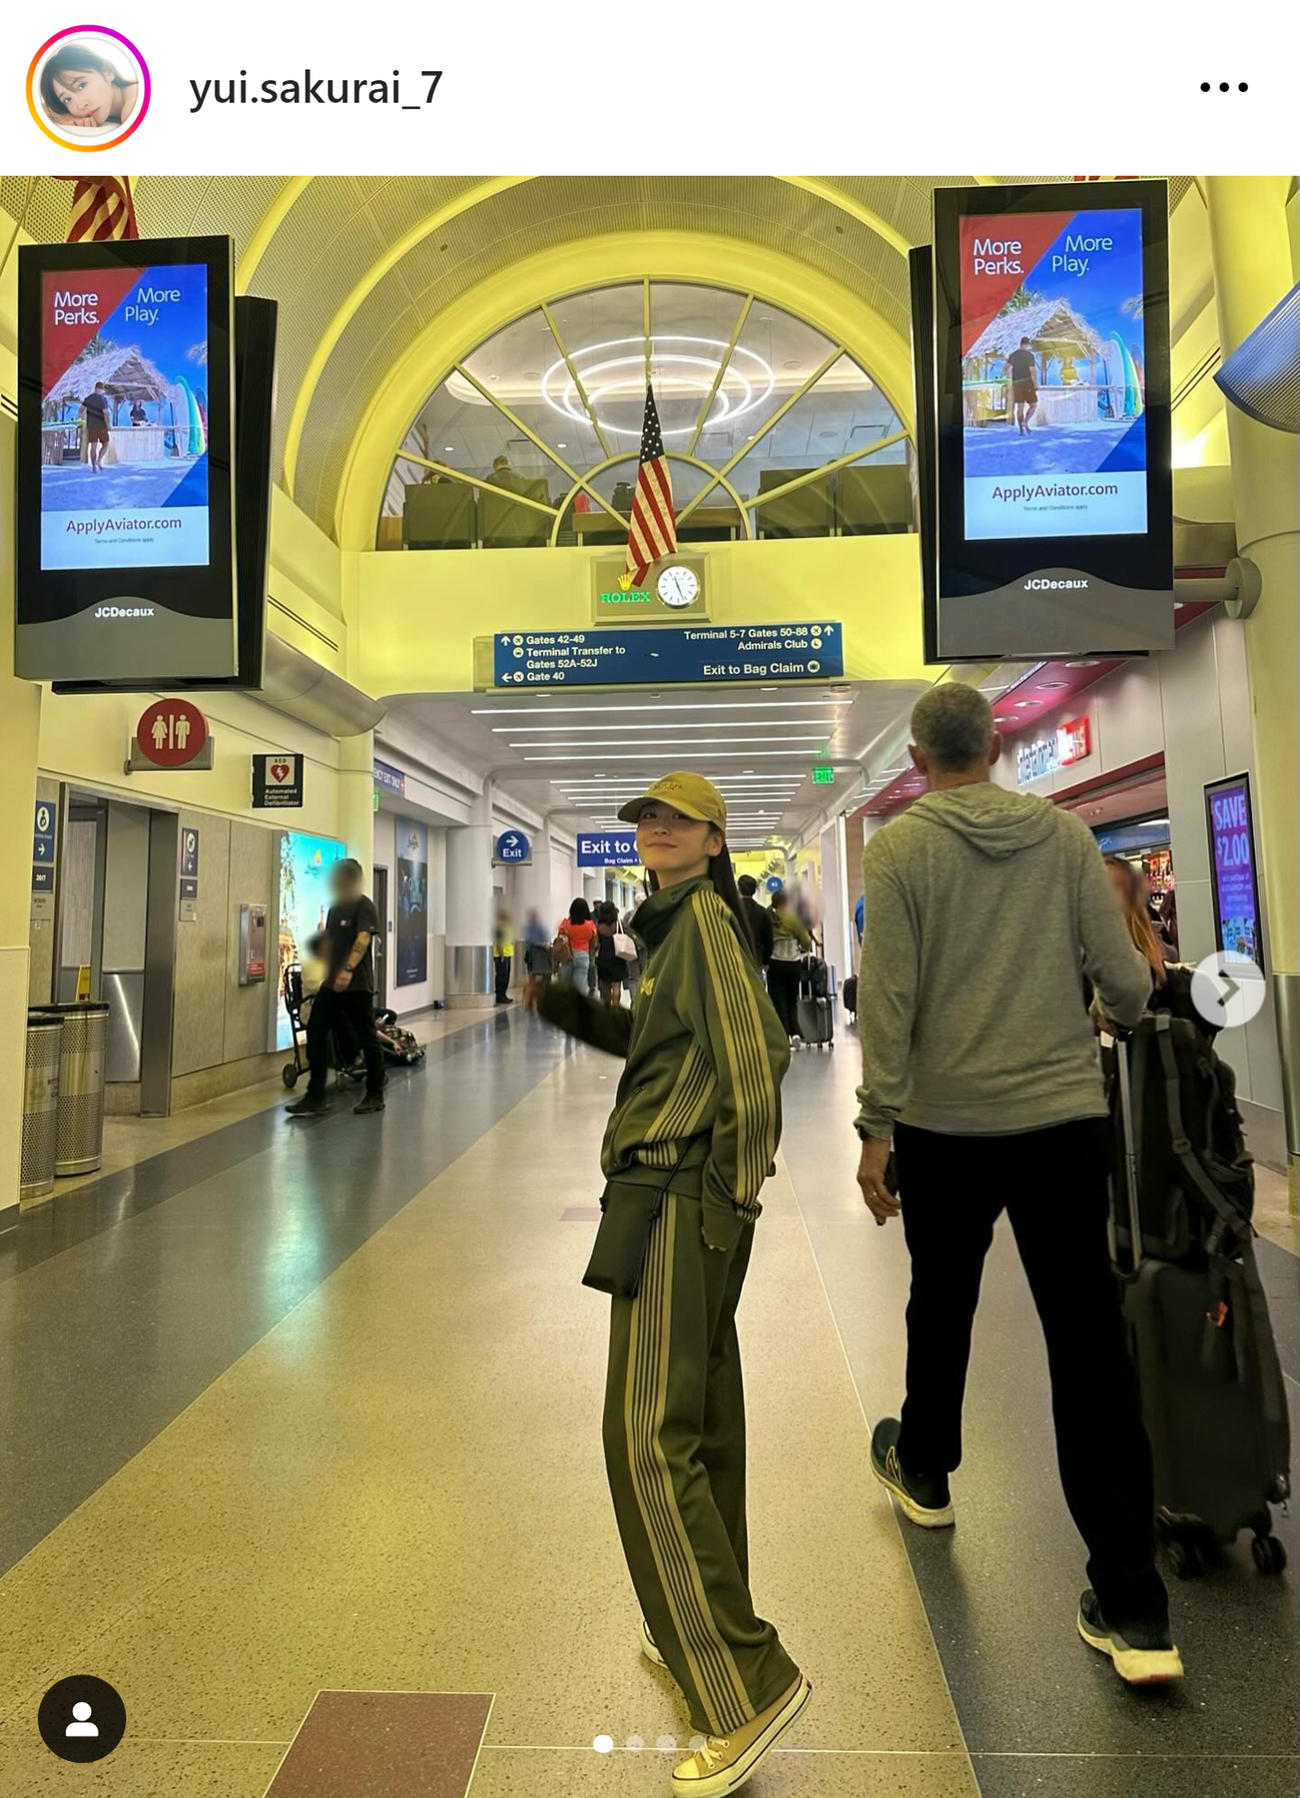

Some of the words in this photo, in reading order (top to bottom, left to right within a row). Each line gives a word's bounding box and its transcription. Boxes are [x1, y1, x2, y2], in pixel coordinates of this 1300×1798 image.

[973, 239, 1022, 256] More
[1065, 235, 1113, 252] More
[974, 257, 1025, 275] Perks.
[1052, 255, 1090, 277] Play.
[54, 291, 99, 307] More
[137, 287, 181, 303] More
[54, 308, 100, 325] Perks.
[124, 306, 159, 326] Play.
[992, 484, 1118, 502] ApplyAviator.com
[66, 517, 182, 535] ApplyAviator.com
[1024, 579, 1089, 591] JCDecaux
[600, 591, 650, 603] ROLEX
[94, 607, 154, 618] JCDecaux
[526, 635, 556, 645] Gates
[557, 634, 585, 644] 42-49
[684, 630, 728, 640] Terminal
[729, 629, 746, 639] 5-7
[748, 628, 778, 638] Gates
[780, 627, 808, 637] 50-88
[526, 647, 570, 657] Terminal
[571, 646, 613, 656] Transfer
[615, 645, 626, 655] to
[737, 641, 782, 650] Admirals
[784, 640, 808, 649] Club
[526, 659, 556, 669] Gates
[557, 658, 598, 668] 52A-52J
[703, 664, 726, 675] Exit
[729, 664, 741, 675] to
[743, 664, 767, 676] Bag
[770, 662, 804, 674] Claim
[526, 672, 551, 681] Gate
[552, 671, 565, 681] 40
[1214, 794, 1247, 831] SAVE
[502, 848, 522, 858] Exit
[581, 840, 611, 854] Exit
[614, 841, 630, 854] to
[1217, 832, 1250, 867] $2.00
